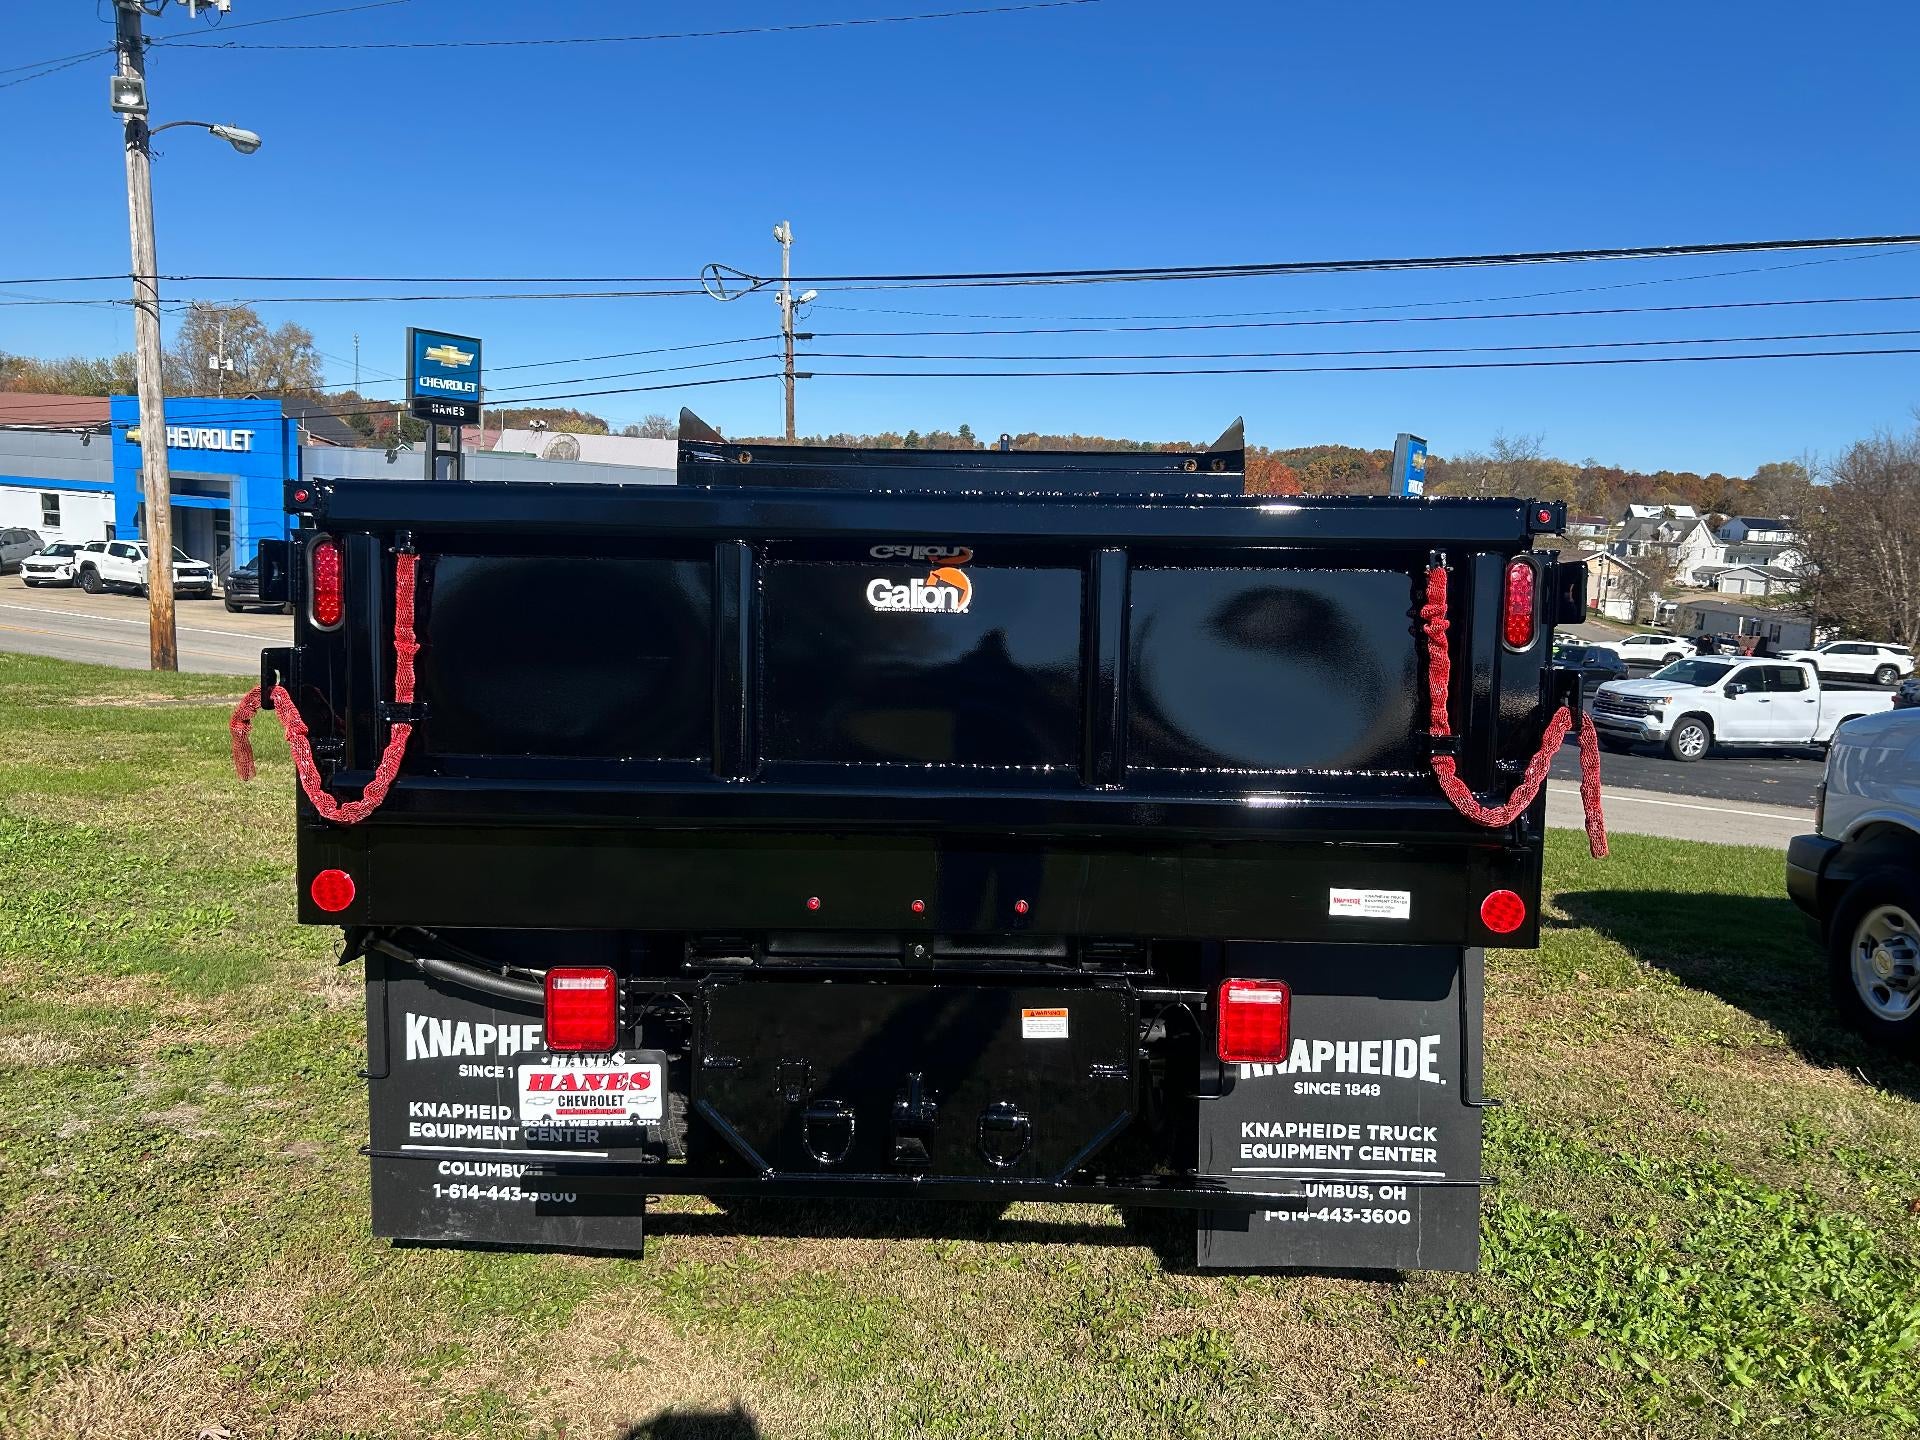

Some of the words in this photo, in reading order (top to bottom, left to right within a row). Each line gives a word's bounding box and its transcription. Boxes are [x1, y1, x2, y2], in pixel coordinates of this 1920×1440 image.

[420, 376, 477, 393] CHEVROLET
[432, 404, 465, 417] HANES
[166, 427, 254, 451] HEVROLET
[866, 578, 959, 609] Galion
[406, 1012, 548, 1060] KNAPHE
[458, 1064, 504, 1078] SINCE
[526, 1071, 651, 1091] HANES
[1294, 1082, 1341, 1095] SINCE
[1345, 1083, 1381, 1096] 1848
[558, 1094, 624, 1107] CHEVROLET
[409, 1101, 512, 1121] KNAPHEID
[521, 1119, 566, 1127] SOUTH
[1241, 1122, 1361, 1139] KNAPHEIDE
[1367, 1124, 1438, 1142] TRUCK
[409, 1122, 519, 1141] EQUIPMENT
[524, 1127, 600, 1143] CENTER
[1240, 1144, 1354, 1160] EQUIPMENT
[1358, 1146, 1437, 1163] CENTER
[438, 1161, 530, 1178] COLUMBU
[1305, 1183, 1374, 1201] UMBUS,
[1378, 1186, 1407, 1200] OH
